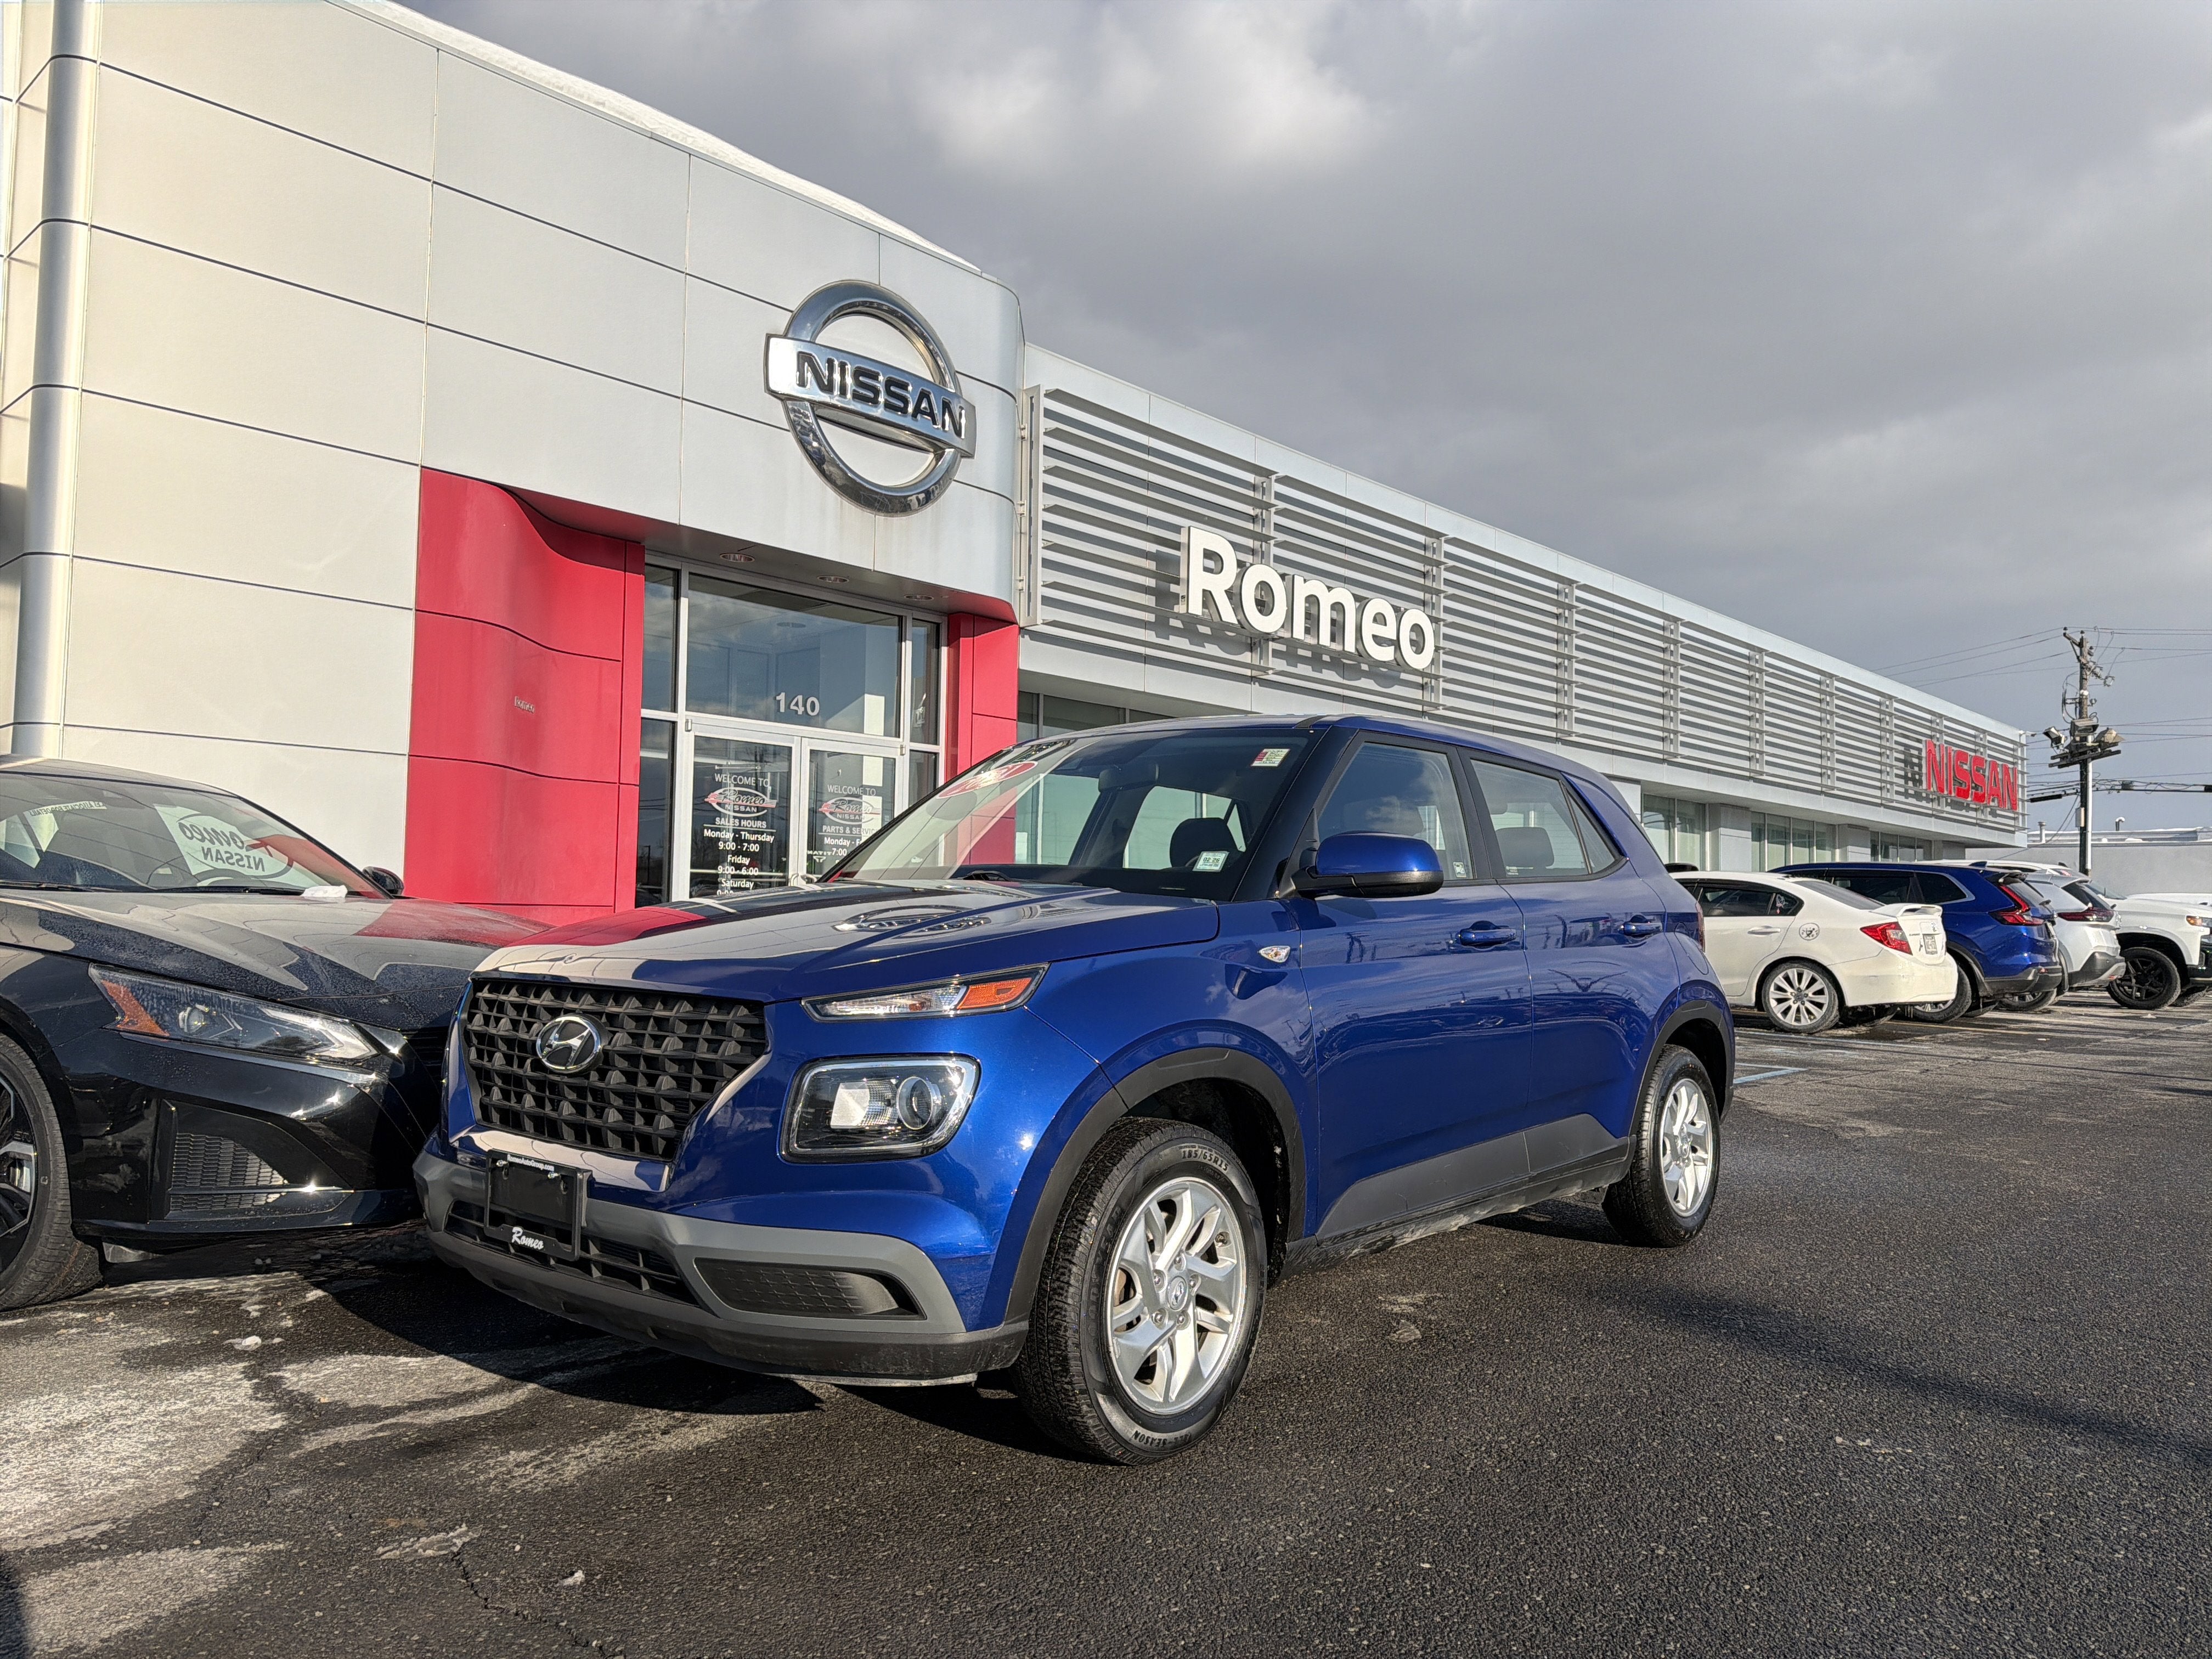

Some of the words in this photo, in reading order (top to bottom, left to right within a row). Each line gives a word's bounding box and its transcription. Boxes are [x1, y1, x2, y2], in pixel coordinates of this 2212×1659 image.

[796, 351, 967, 440] NISSAN
[1180, 525, 1435, 670] Romeo
[776, 692, 820, 716] 140
[714, 772, 756, 786] WELCOME
[758, 777, 770, 787] TO
[1923, 739, 2018, 812] NISSAN
[718, 789, 765, 805] Romeo
[827, 784, 864, 795] WELCOME
[865, 787, 876, 796] TO
[725, 804, 757, 812] NISSAN
[832, 798, 872, 814] Romeo
[715, 817, 740, 826] SALES
[741, 819, 767, 828] HOURS
[822, 825, 844, 833] PARTS
[703, 828, 734, 840] Monday
[740, 831, 775, 843] Thursday
[824, 837, 851, 847] Monday
[718, 841, 736, 850] 9:00
[742, 843, 760, 852] 7:00
[832, 848, 847, 856] 7:00
[727, 854, 751, 865] Friday
[718, 865, 735, 874] 9:00
[741, 867, 759, 876] 6:00
[721, 878, 754, 891] Saturday
[507, 1154, 555, 1172] RomeoAutoGroup.com
[1182, 1149, 1229, 1171] 185/65R15
[511, 1226, 545, 1250] Romeo
